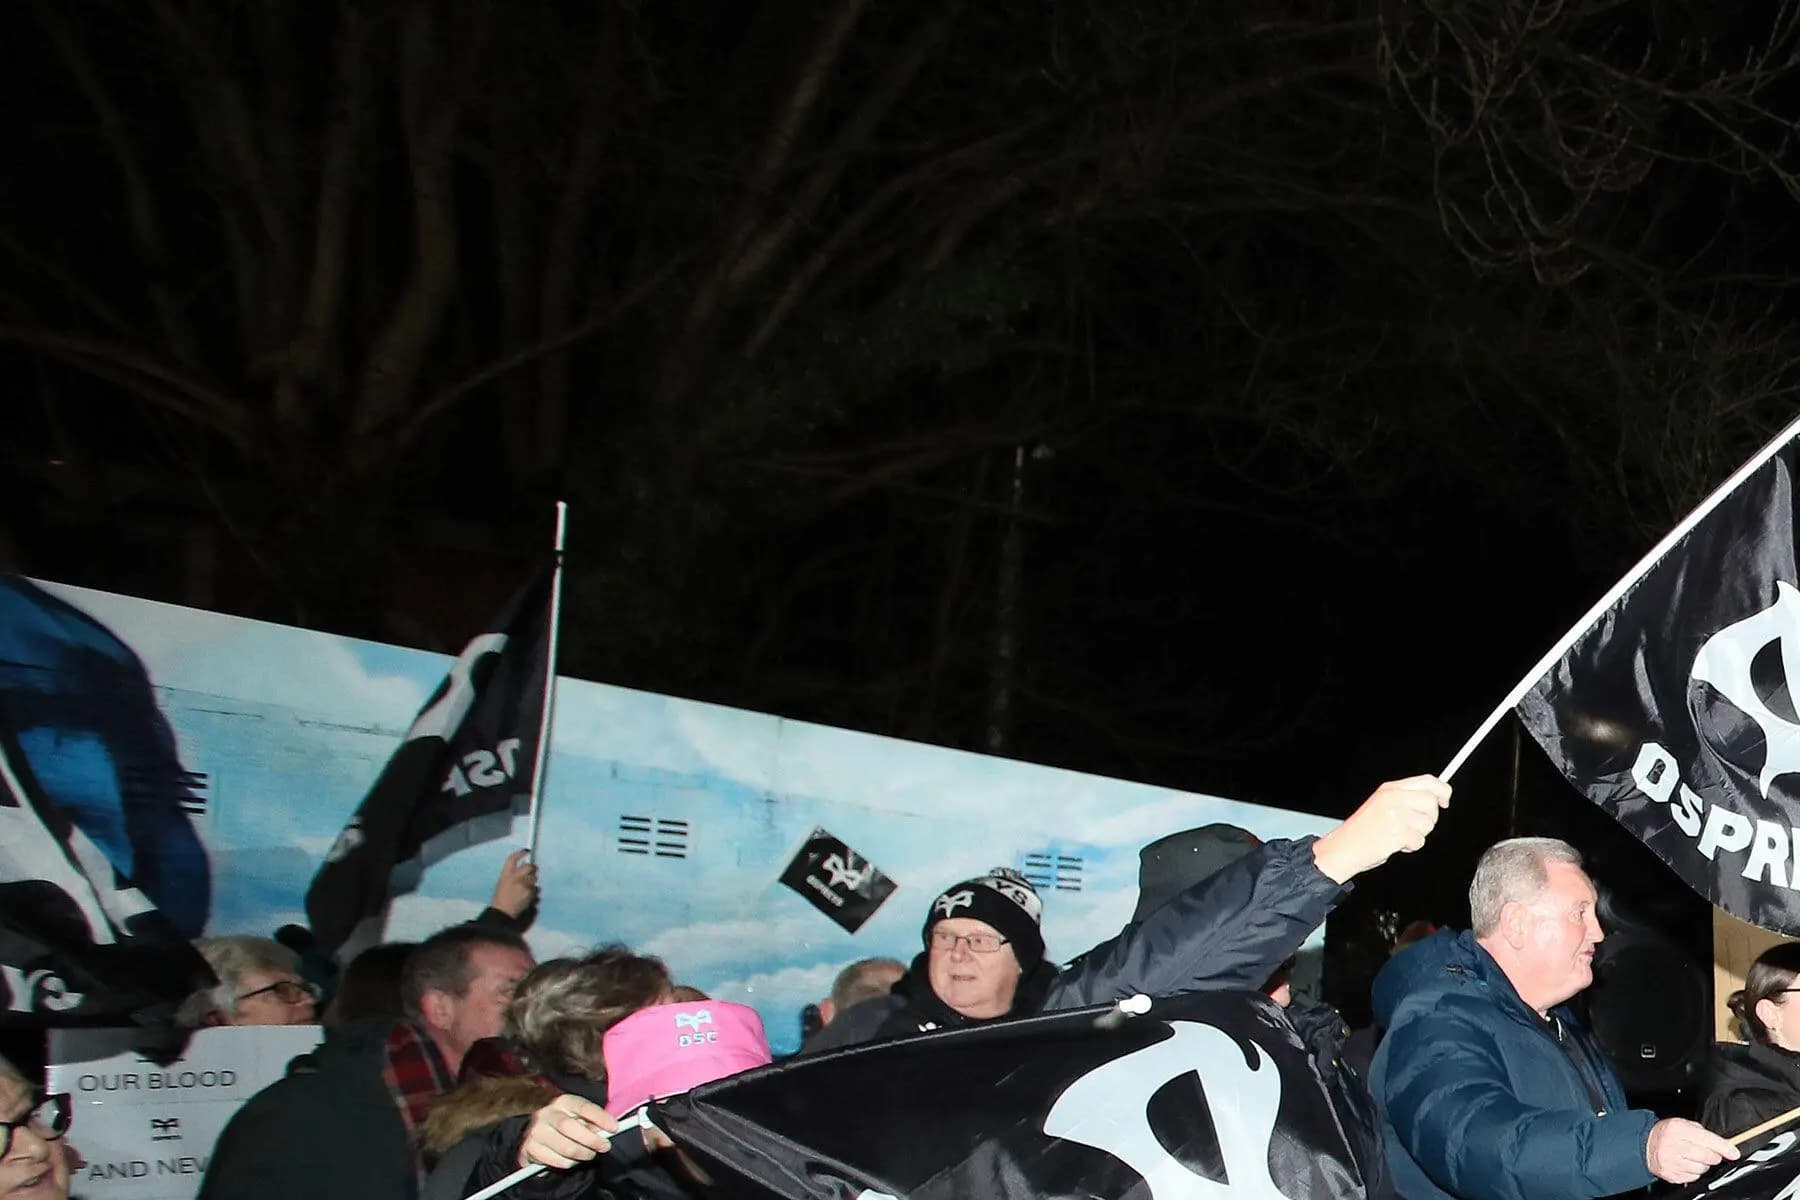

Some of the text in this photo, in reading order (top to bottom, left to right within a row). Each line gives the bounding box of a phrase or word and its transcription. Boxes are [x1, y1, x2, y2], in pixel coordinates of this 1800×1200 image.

[78, 1070, 238, 1091] OUR BLOOD
[88, 1160, 148, 1181] AND
